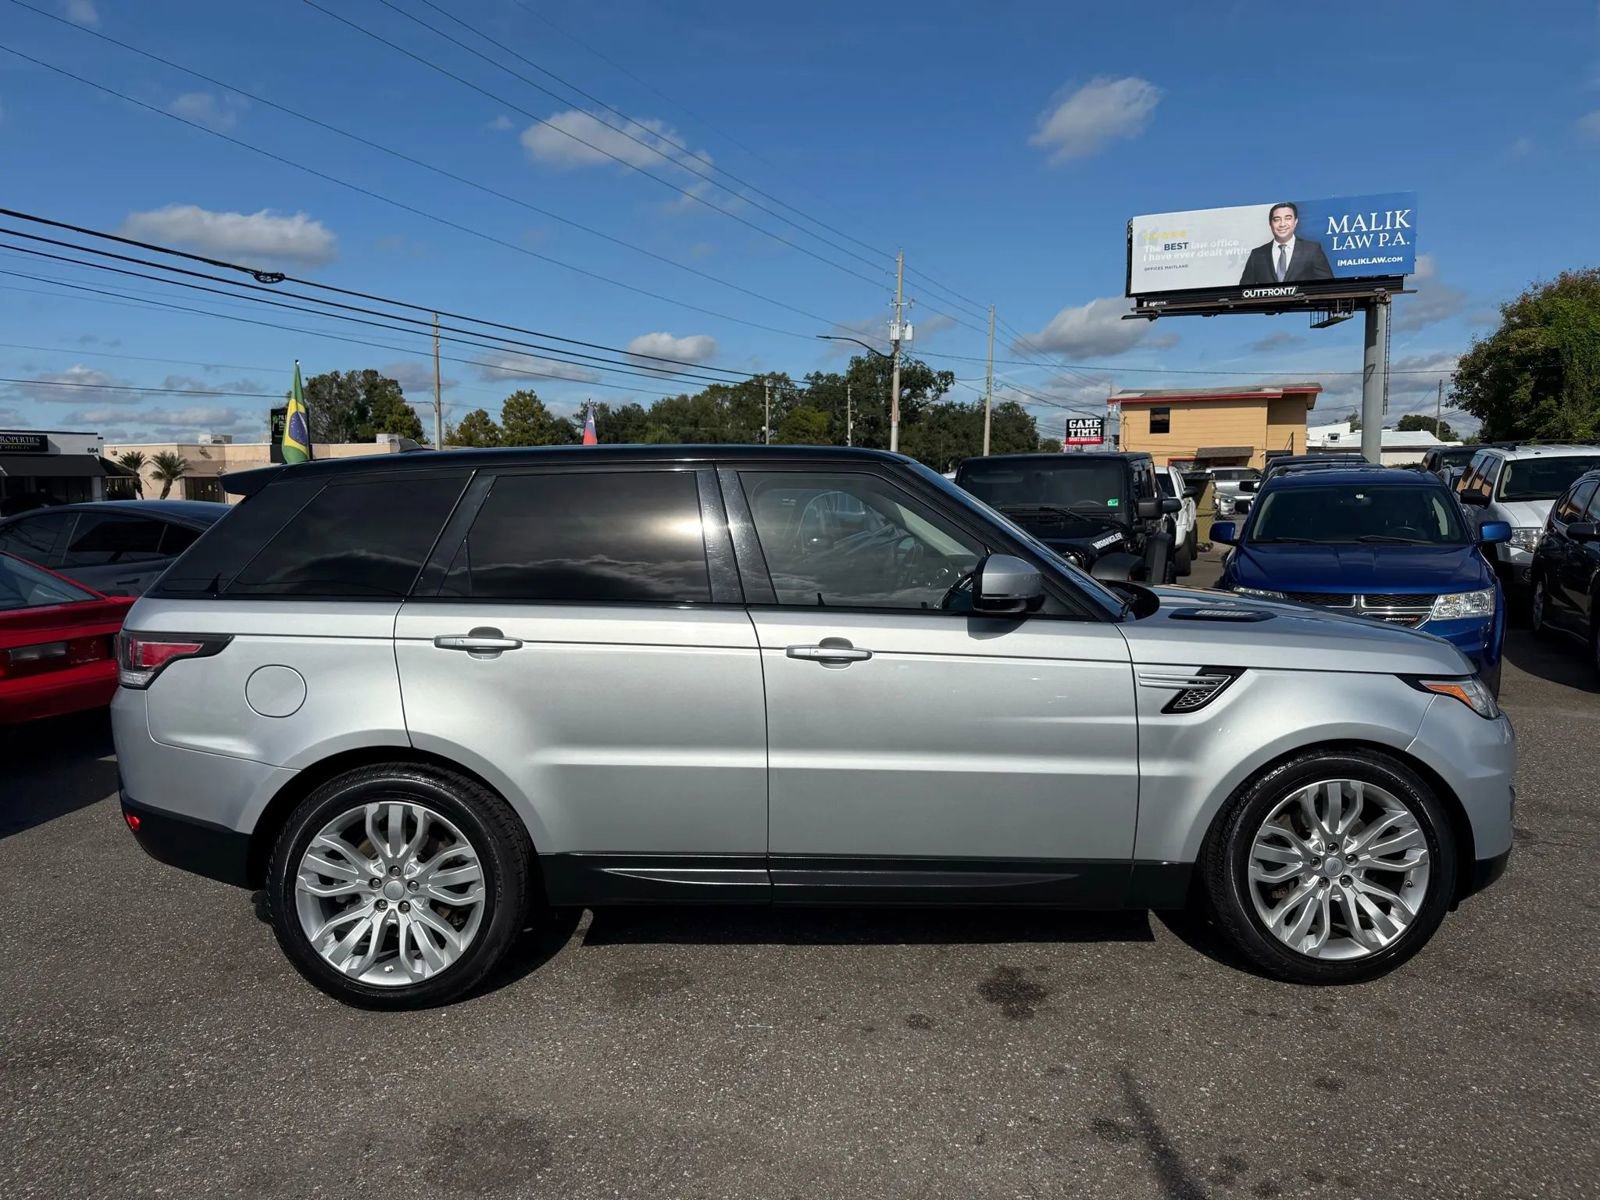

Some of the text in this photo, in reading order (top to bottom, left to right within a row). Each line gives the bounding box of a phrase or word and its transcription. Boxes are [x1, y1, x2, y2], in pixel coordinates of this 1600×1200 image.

[1326, 209, 1411, 235] MALIK
[1164, 241, 1189, 251] BEST
[1332, 231, 1410, 251] LAW P.A.
[1069, 419, 1102, 428] GAME
[1069, 428, 1101, 437] TIME!
